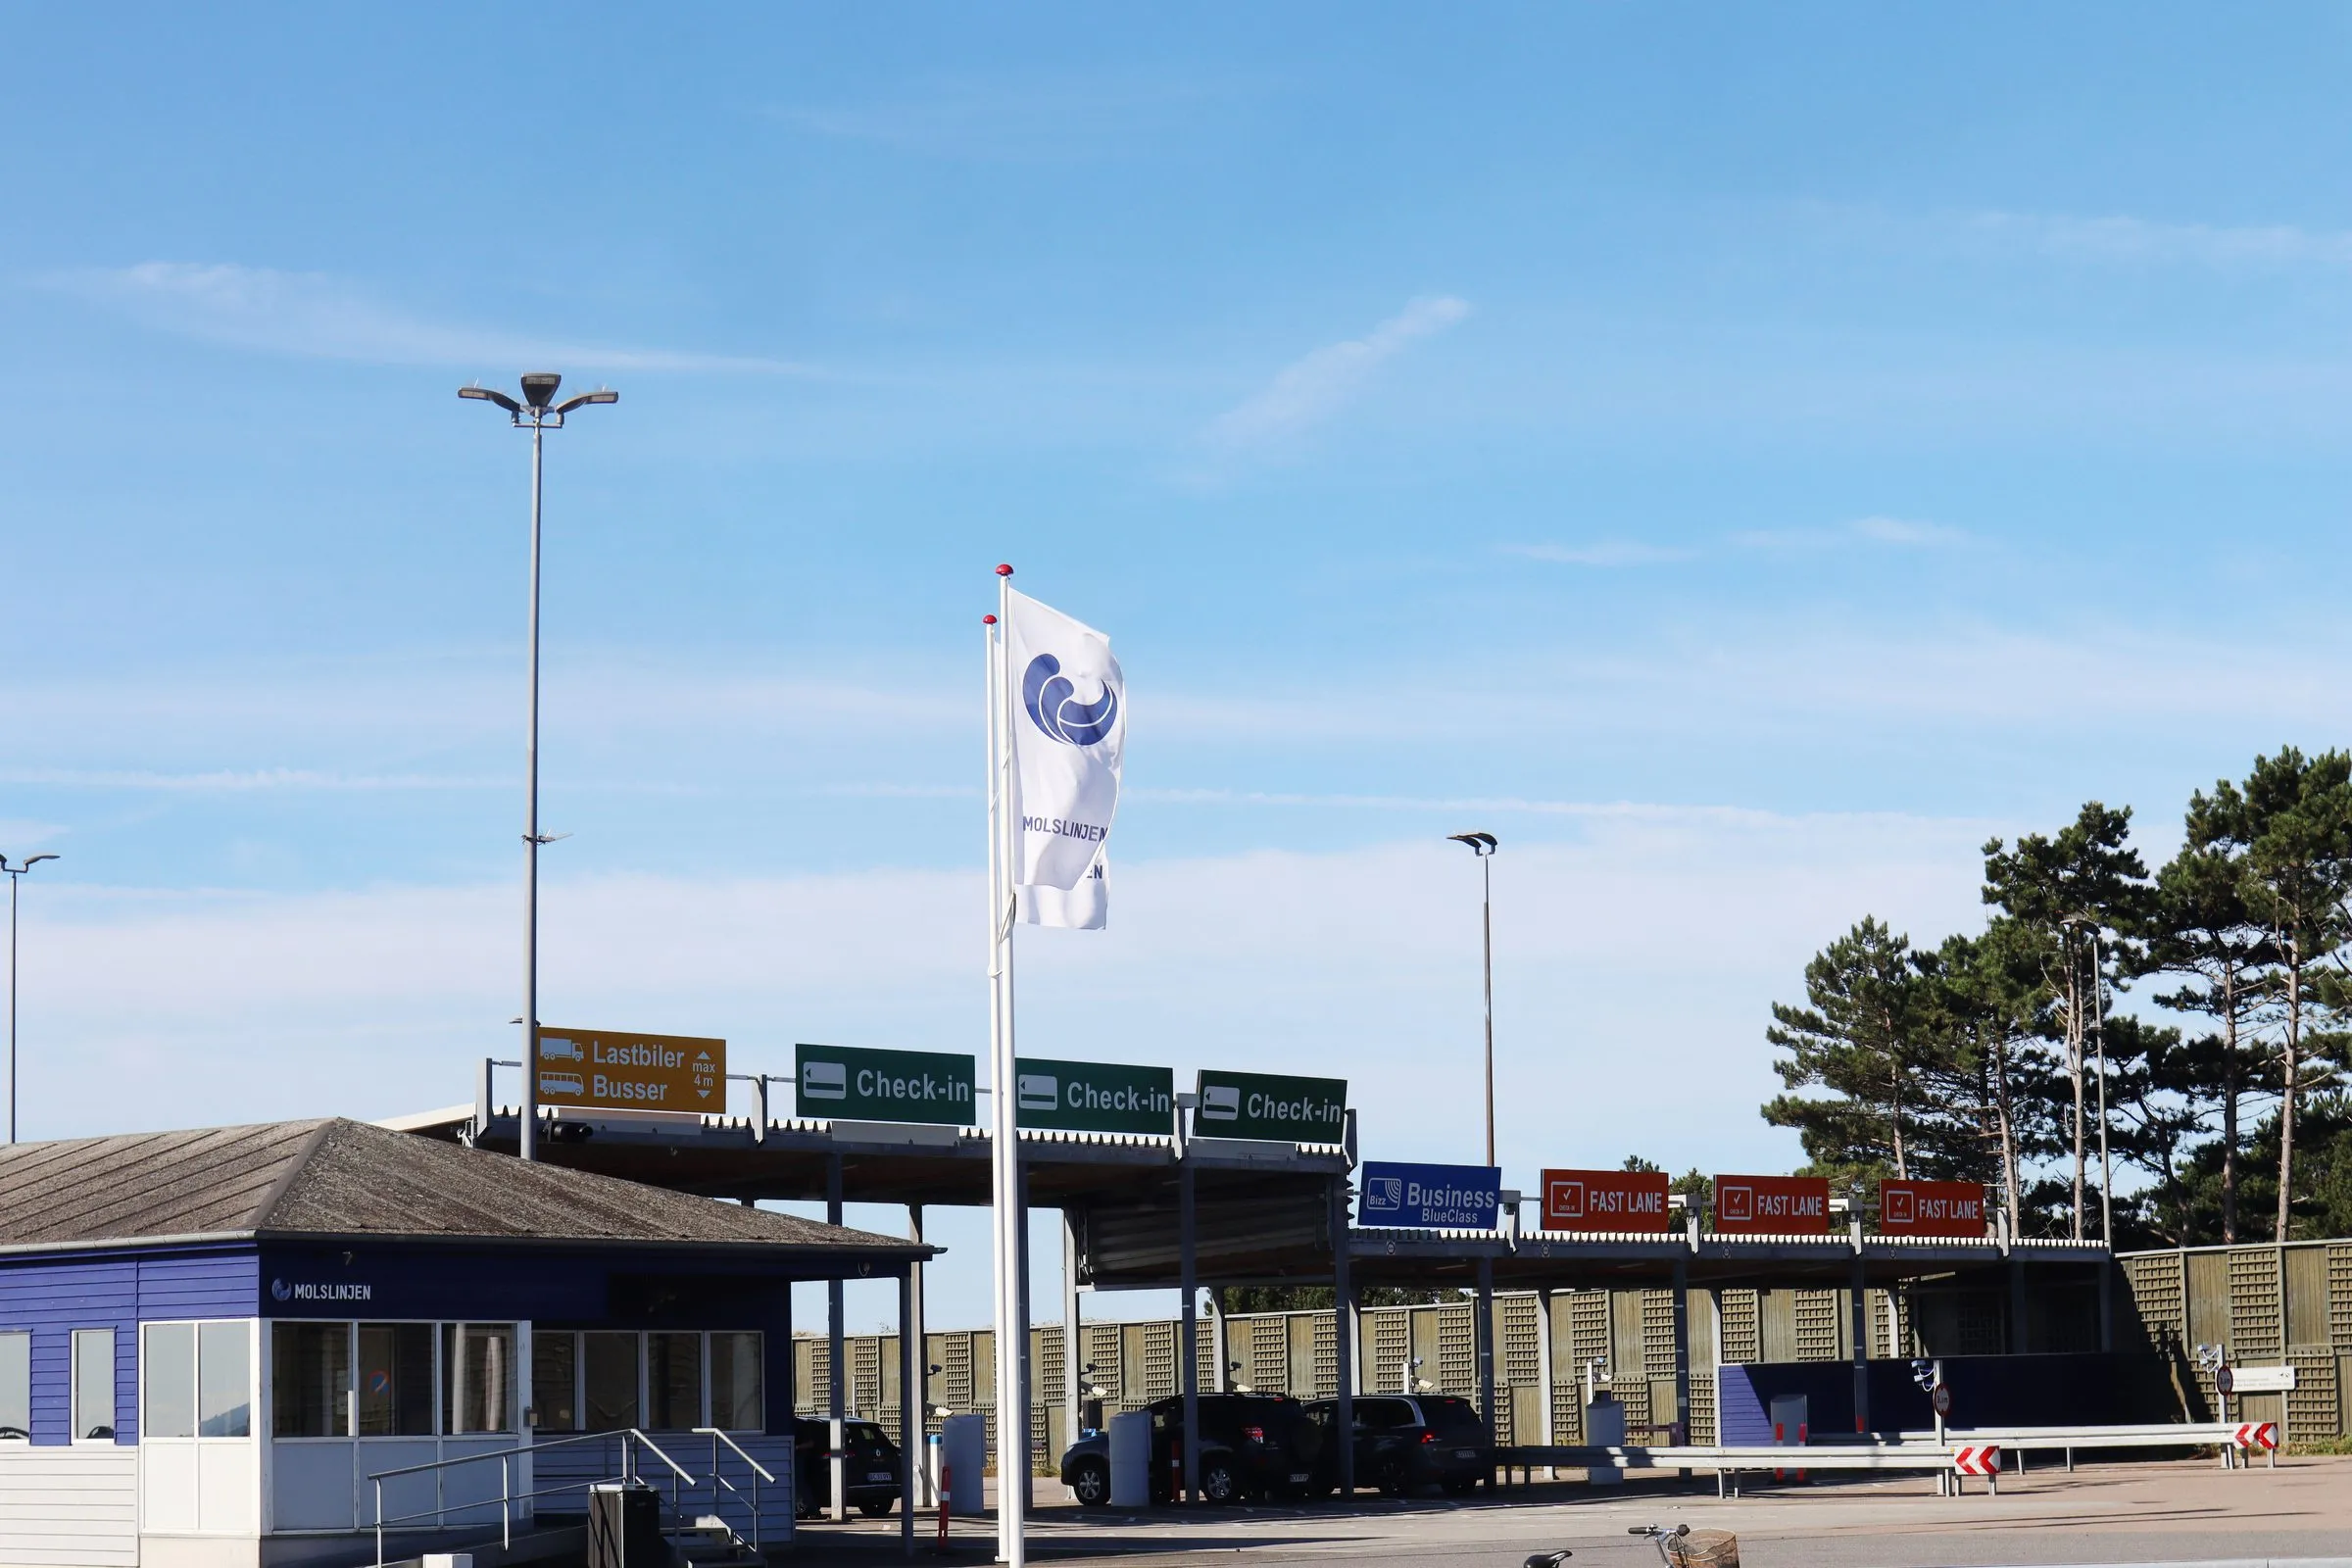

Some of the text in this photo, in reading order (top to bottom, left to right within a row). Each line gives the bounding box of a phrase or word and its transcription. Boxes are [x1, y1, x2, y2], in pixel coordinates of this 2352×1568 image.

[1022, 815, 1108, 842] MOLSLINJEN
[593, 1041, 685, 1068] Lastbiler
[693, 1061, 715, 1073] max
[593, 1074, 667, 1101] Busser
[694, 1074, 713, 1087] 4 m
[857, 1069, 969, 1102] Check-in
[1067, 1082, 1169, 1112] Check-in
[1248, 1093, 1342, 1123] Check-in
[1369, 1195, 1387, 1205] Bizz
[1407, 1182, 1495, 1208] Business
[1590, 1191, 1662, 1213] FAST LANE
[1757, 1195, 1823, 1216] FAST LANE
[1422, 1207, 1478, 1224] BlueClass
[1919, 1199, 1979, 1220] FAST LANE
[294, 1284, 371, 1300] MOLSLINJEN
